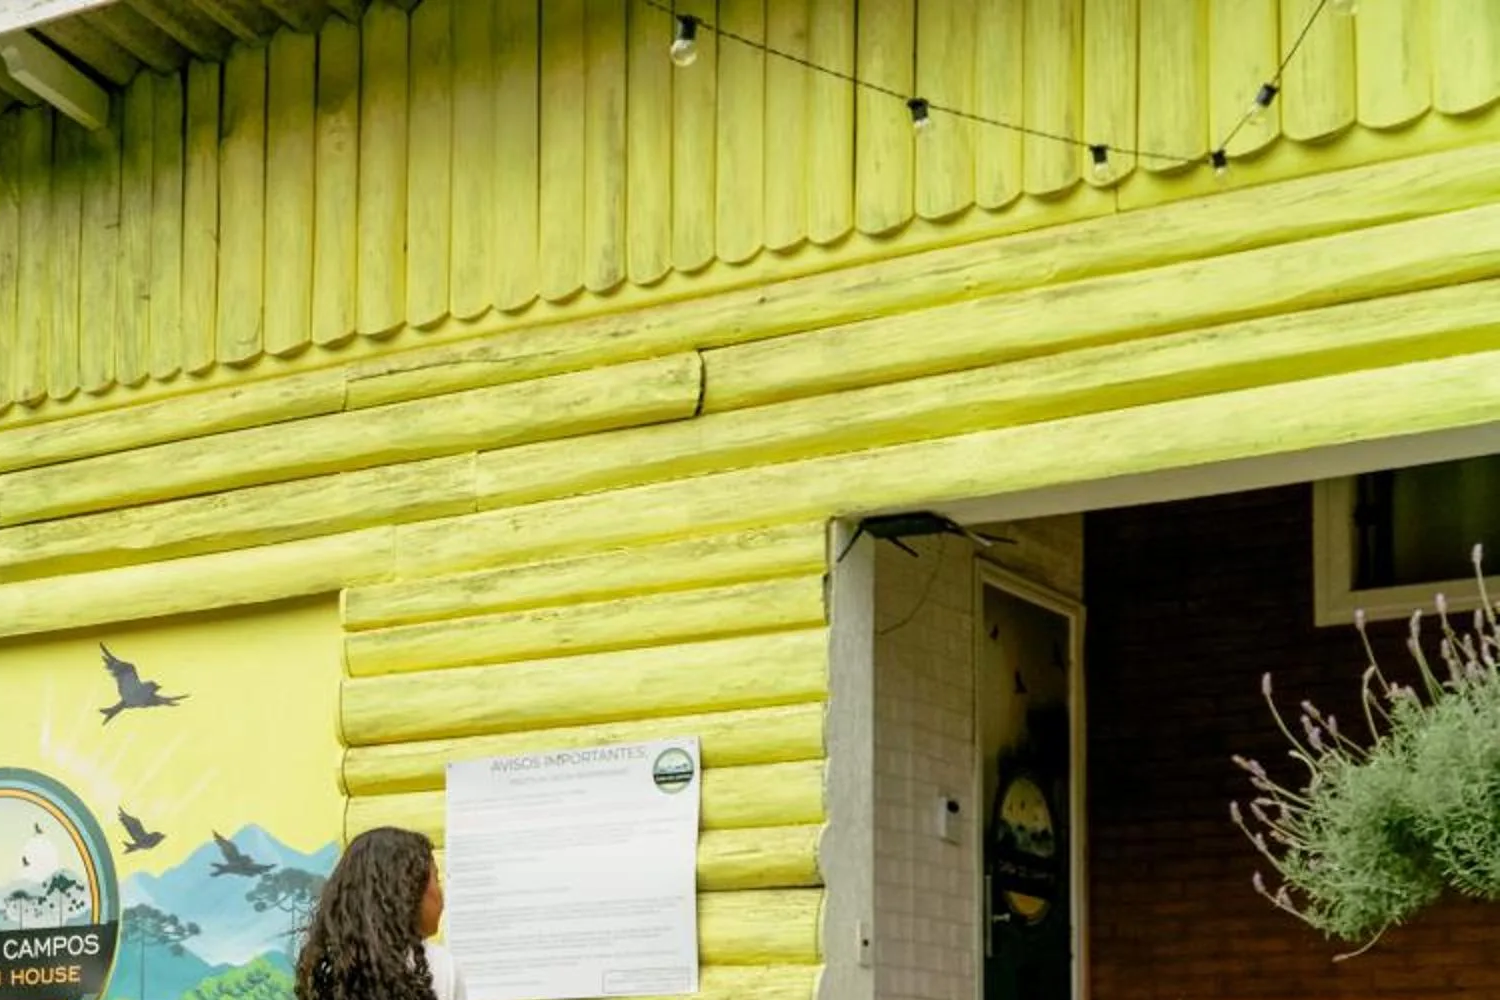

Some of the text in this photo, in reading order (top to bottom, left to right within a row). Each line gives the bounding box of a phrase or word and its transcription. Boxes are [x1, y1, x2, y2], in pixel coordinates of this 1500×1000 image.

[490, 756, 541, 772] AVISOS
[3, 934, 100, 960] CAMPOS
[11, 966, 81, 986] HOUSE
